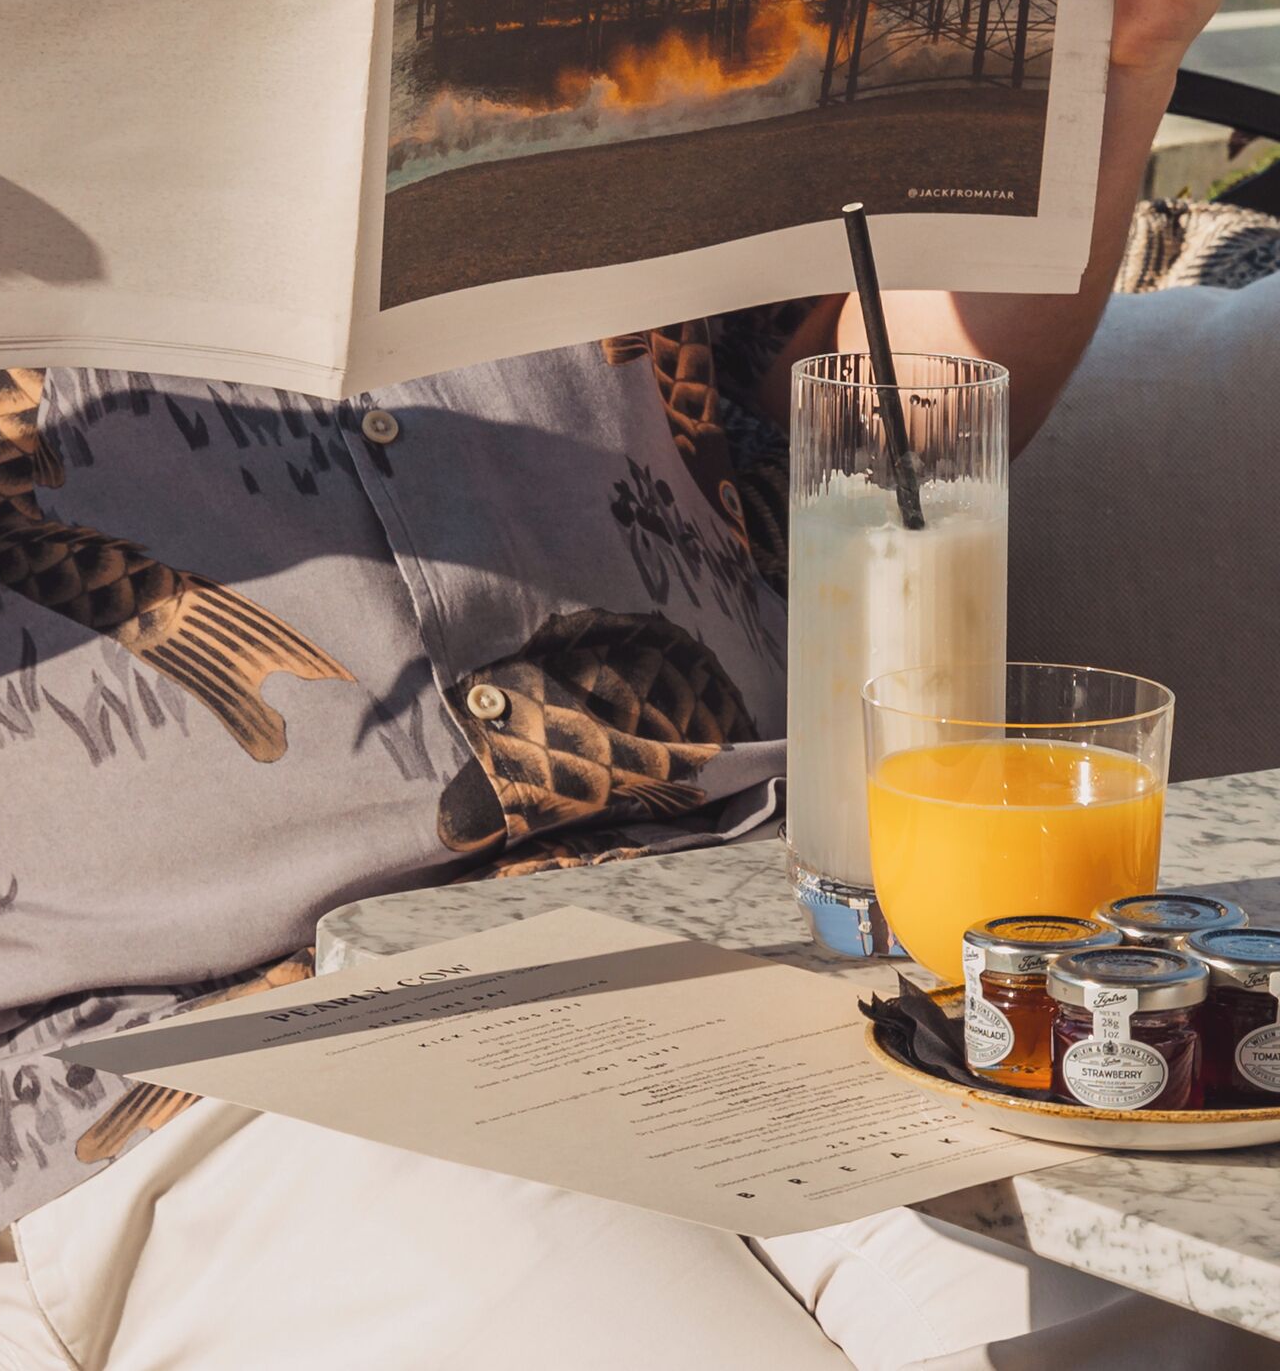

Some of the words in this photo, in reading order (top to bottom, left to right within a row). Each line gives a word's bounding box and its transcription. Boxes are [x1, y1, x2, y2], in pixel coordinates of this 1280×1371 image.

[907, 188, 1015, 200] @JACKFROMAFAR
[266, 987, 389, 1021] PEARLY
[397, 964, 469, 987] COW
[1093, 992, 1127, 1008] Tiptree
[369, 1013, 422, 1029] START
[430, 1002, 464, 1011] THE
[472, 990, 506, 1000] DAY
[418, 1034, 461, 1047] KICK
[472, 1014, 540, 1032] THINGS
[550, 1003, 581, 1012] OFF
[1102, 1018, 1119, 1029] 28g
[969, 1025, 1006, 1040] MARMALADE
[1103, 1029, 1119, 1038] 1oz
[1252, 1032, 1275, 1045] WILKIN
[583, 1064, 618, 1075] HOT
[628, 1046, 679, 1062] STUFF
[1121, 1047, 1140, 1058] SONS
[1142, 1051, 1154, 1064] LTD
[1082, 1068, 1143, 1079] STRAWBERRY
[857, 1132, 888, 1140] PER
